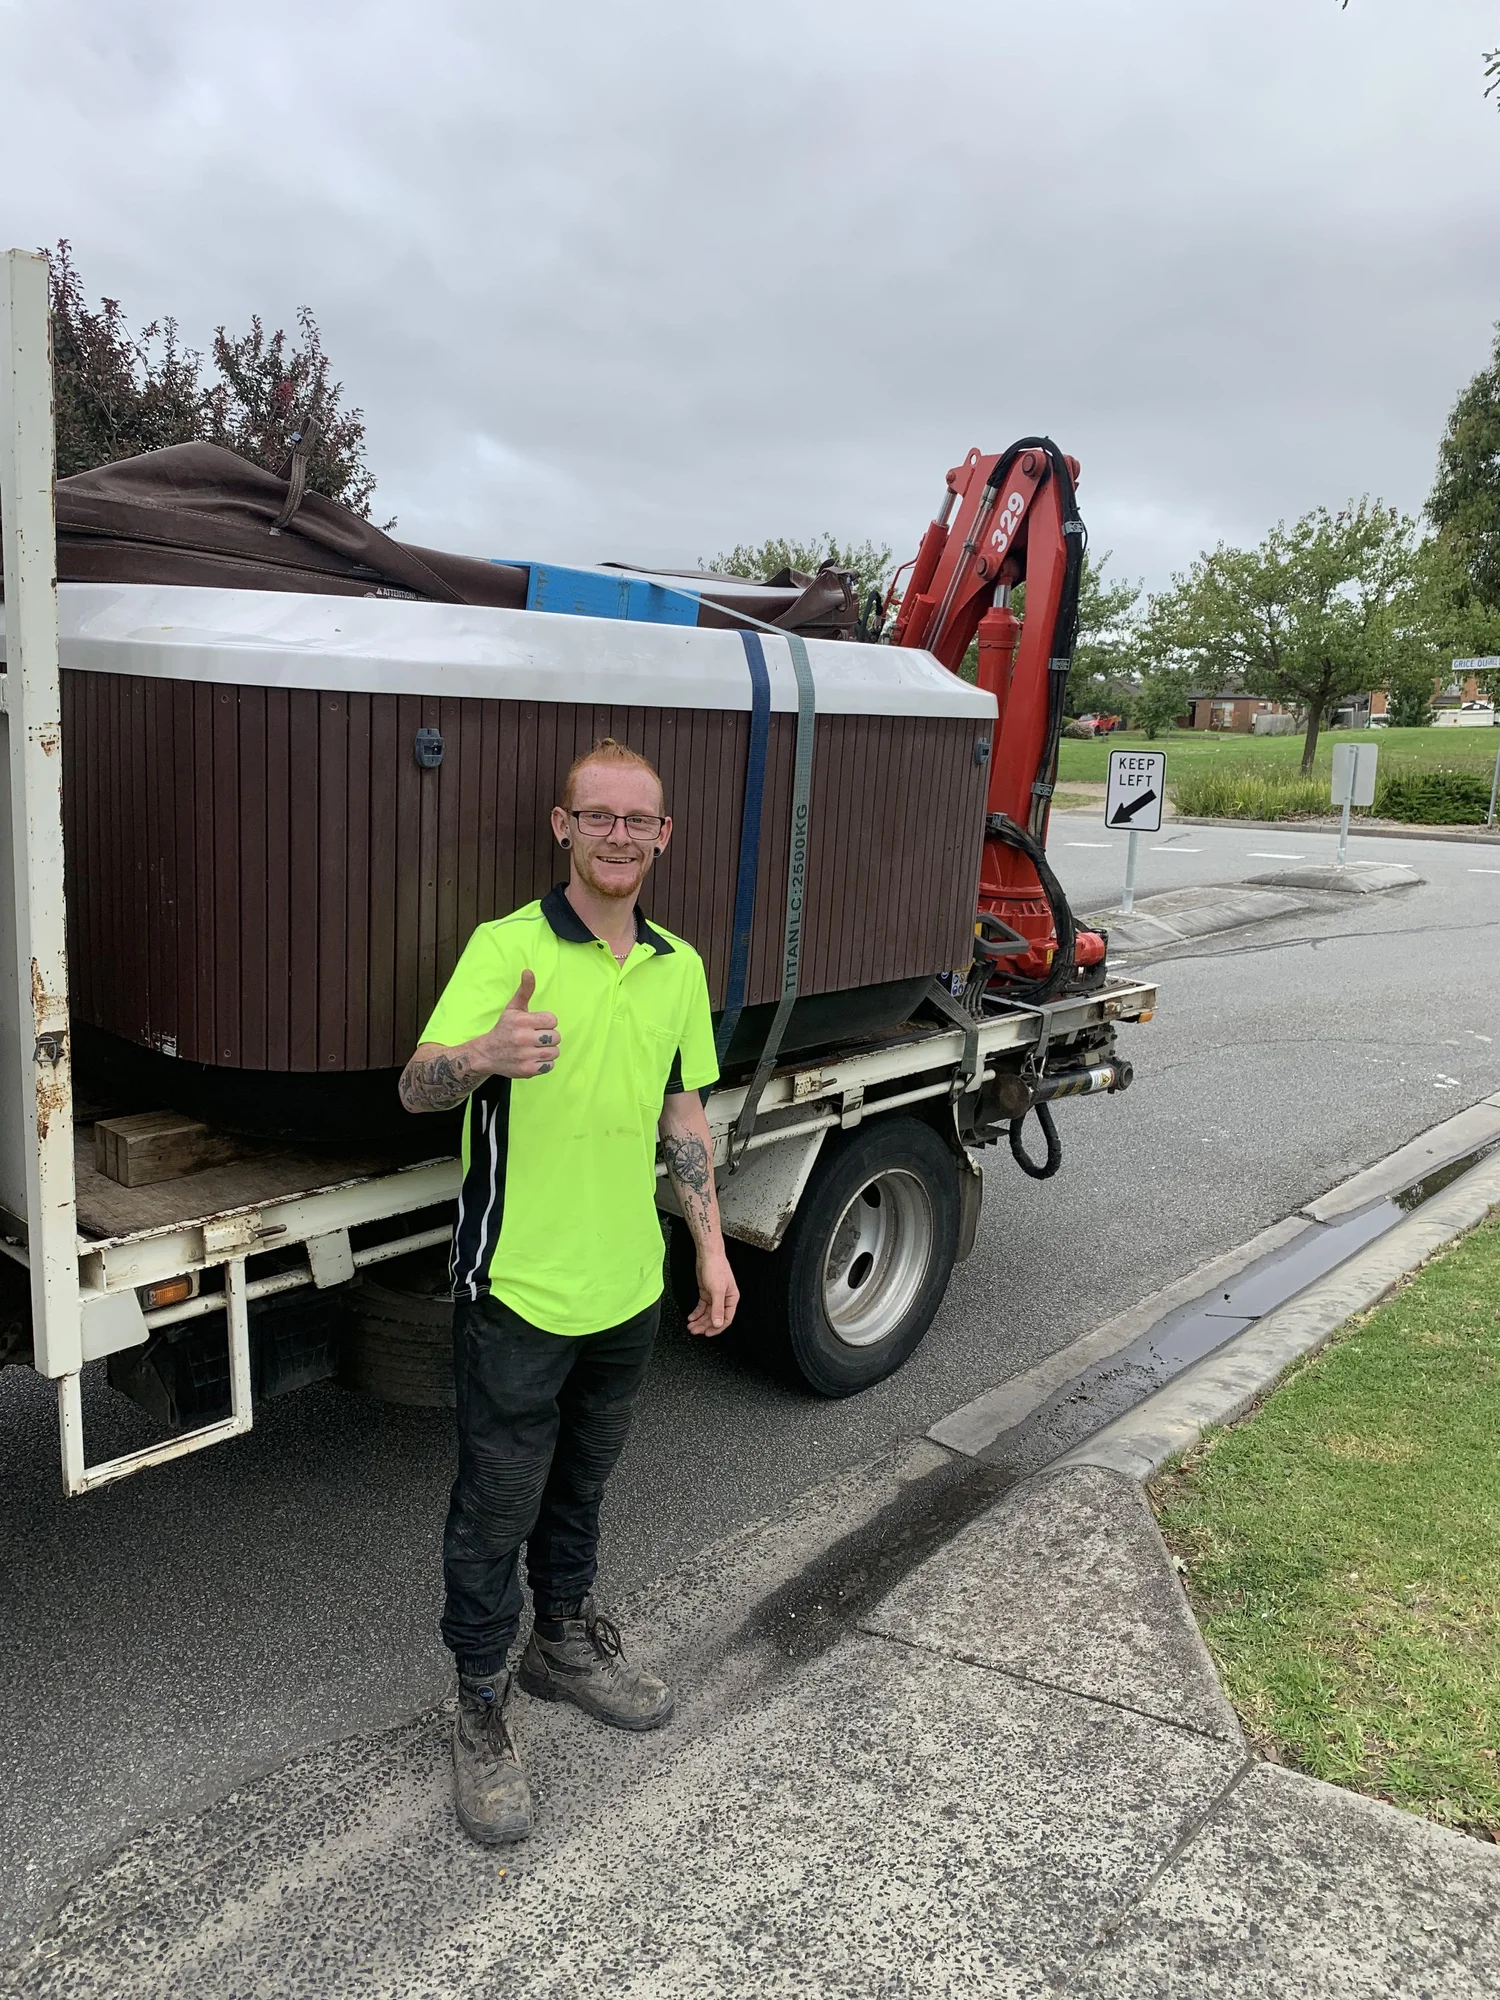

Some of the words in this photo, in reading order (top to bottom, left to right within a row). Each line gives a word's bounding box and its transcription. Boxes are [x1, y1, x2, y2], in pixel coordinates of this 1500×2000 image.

[991, 491, 1025, 553] 329
[1453, 660, 1475, 668] GRICE
[1119, 757, 1156, 771] KEEP
[1119, 773, 1153, 787] LEFT
